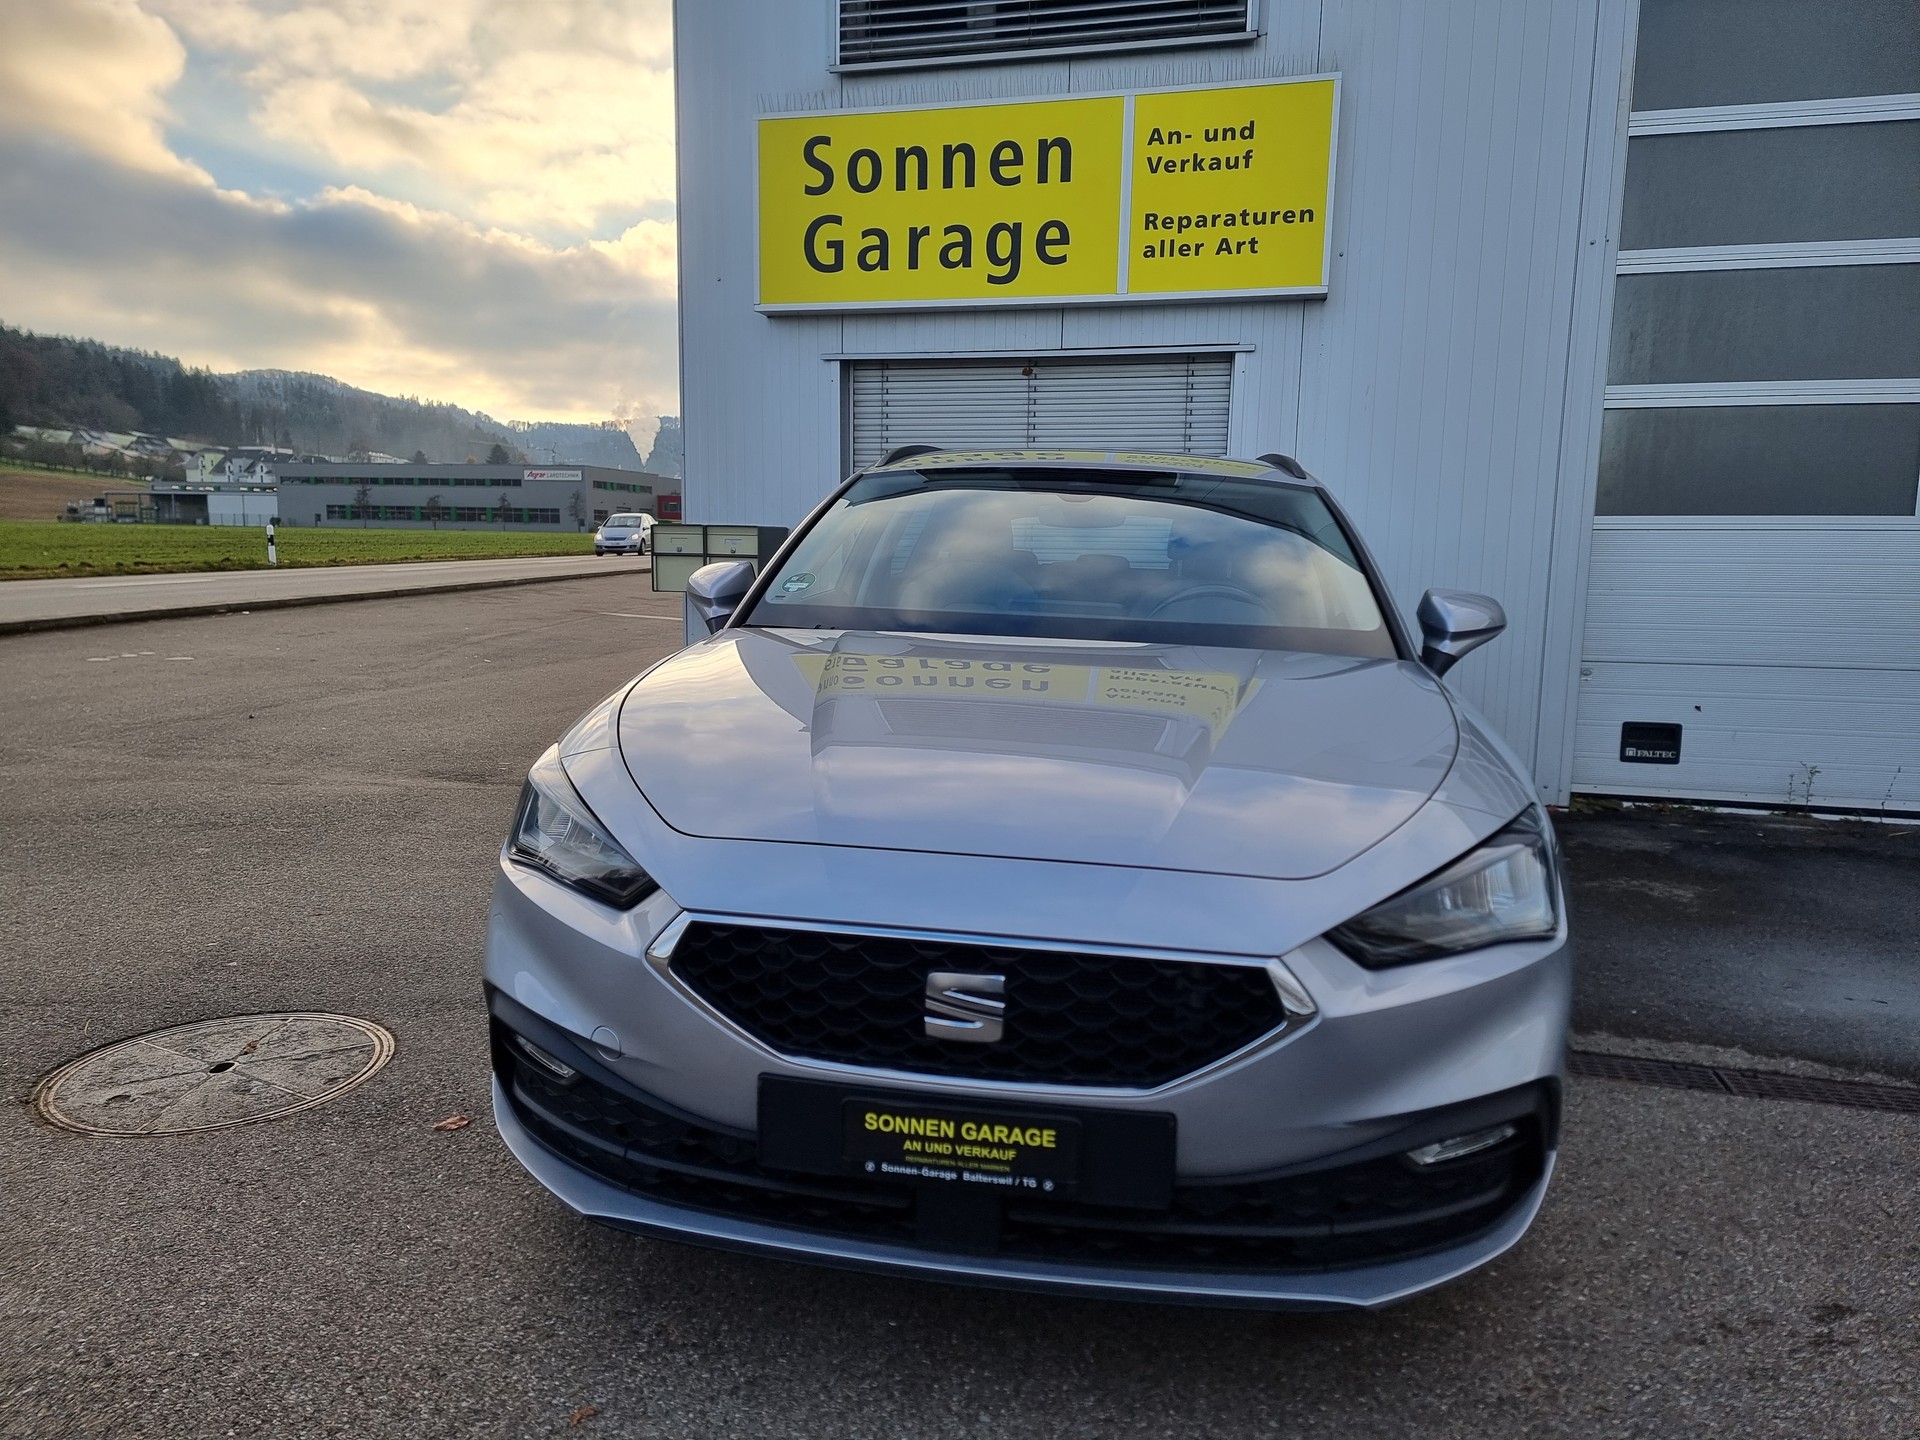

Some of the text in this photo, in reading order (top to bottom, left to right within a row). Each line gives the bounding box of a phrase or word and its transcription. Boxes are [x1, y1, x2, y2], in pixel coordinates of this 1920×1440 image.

[1146, 119, 1255, 146] An- und
[803, 135, 1072, 197] Sonnen
[1146, 149, 1254, 174] Verkauf
[1144, 208, 1314, 231] Reparaturen
[803, 214, 1072, 286] Garage
[1142, 236, 1259, 259] aller Art
[1637, 749, 1676, 758] FALTEC
[864, 1112, 1056, 1148] SONNEN GARAGE
[903, 1139, 1017, 1161] AN UND VERKAUF
[881, 1162, 957, 1180] Sonnen-Garage
[1022, 1176, 1037, 1188] TG
